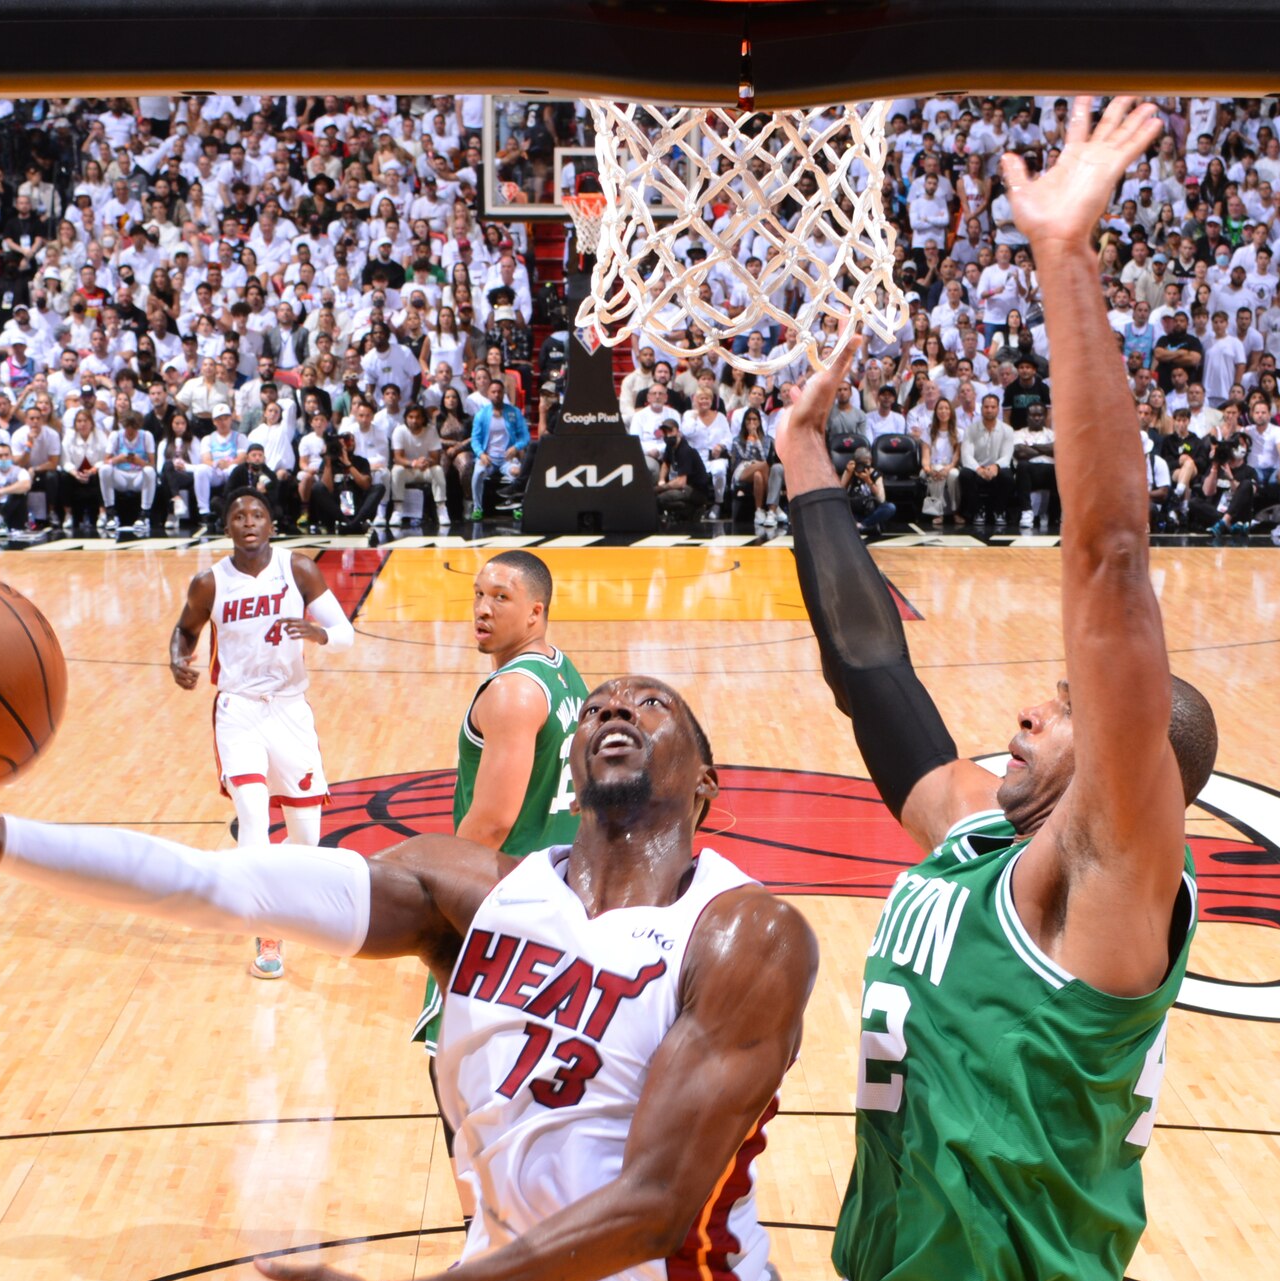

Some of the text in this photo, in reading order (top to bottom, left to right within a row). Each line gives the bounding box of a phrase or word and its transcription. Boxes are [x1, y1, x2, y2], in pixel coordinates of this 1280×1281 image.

[563, 412, 619, 426] Google Pixel
[545, 464, 634, 489] KIA
[222, 584, 289, 624] HEAT
[264, 617, 284, 646] 4
[631, 926, 674, 951] UKG
[451, 928, 667, 1042] HEAT
[496, 1021, 603, 1110] 13
